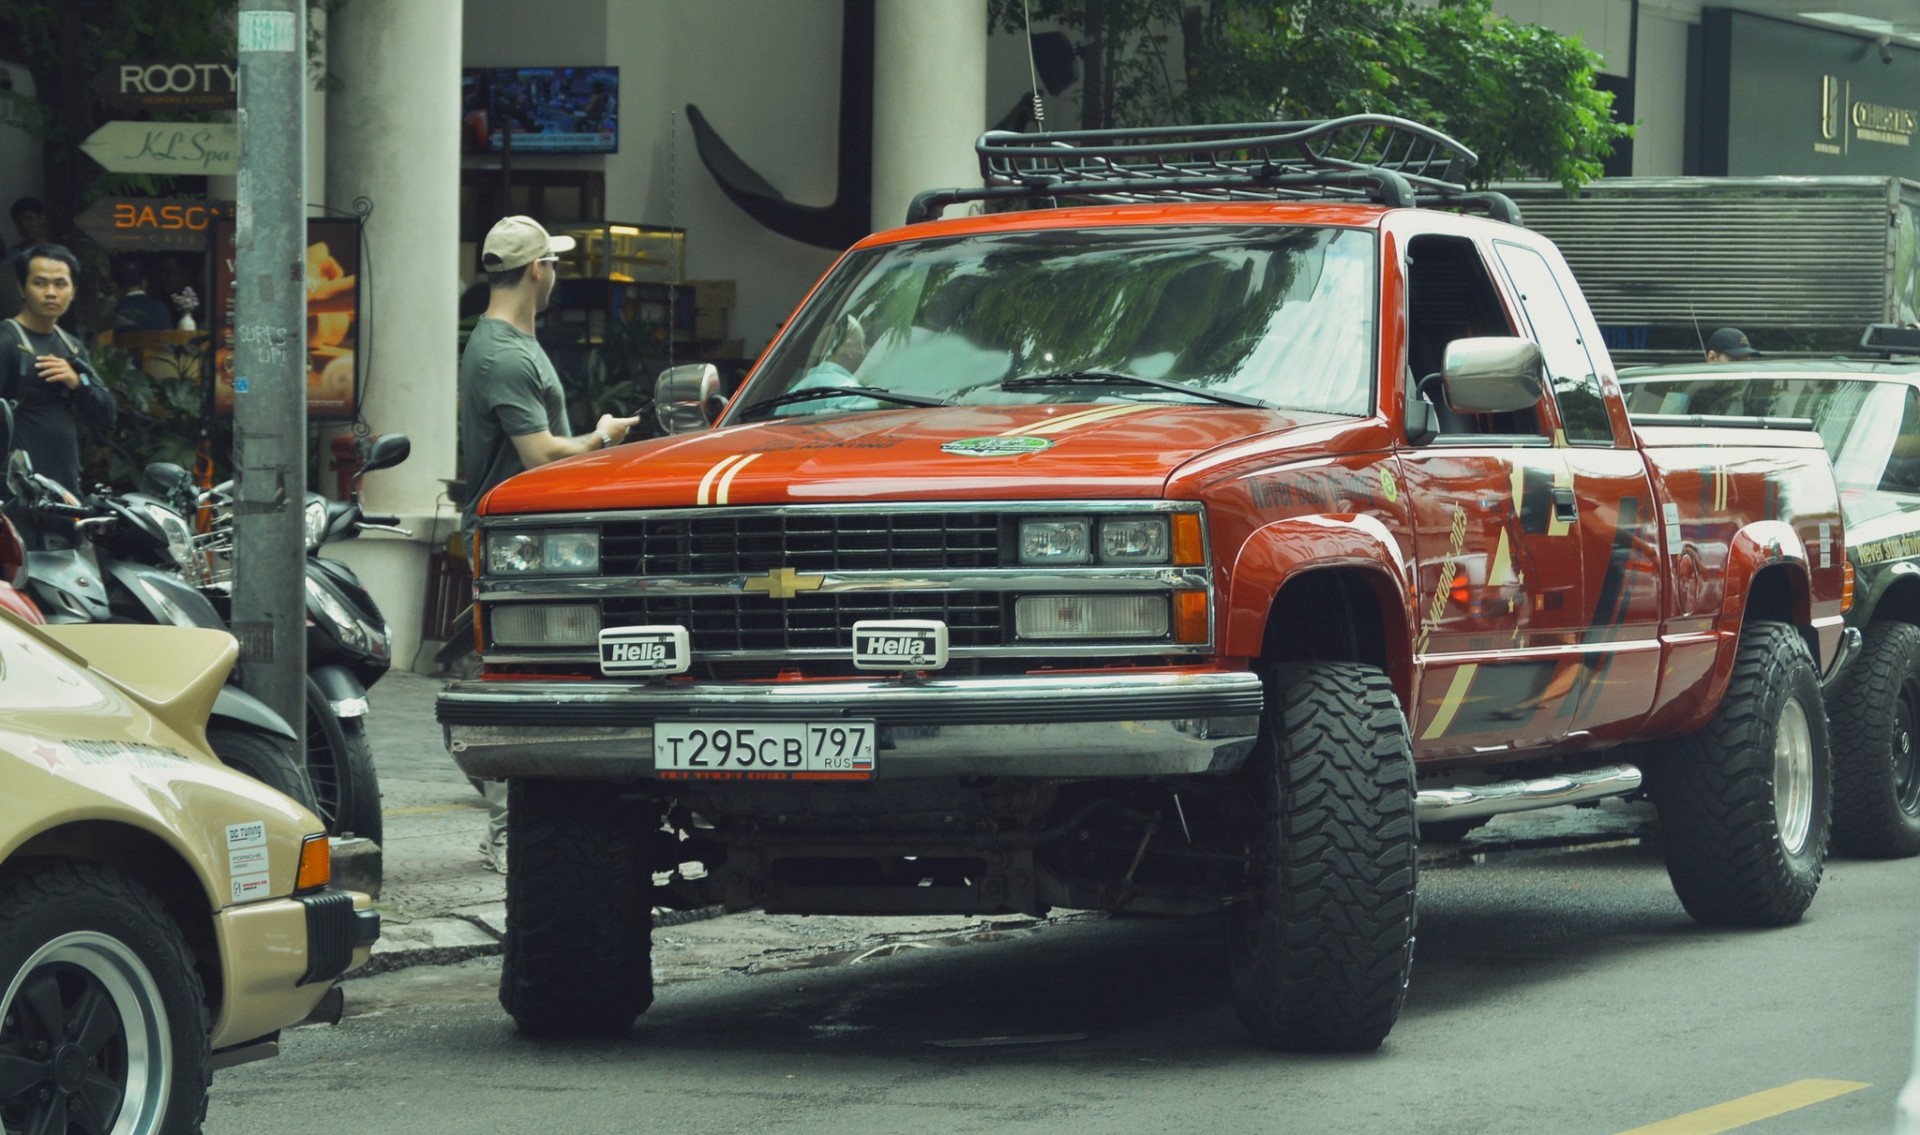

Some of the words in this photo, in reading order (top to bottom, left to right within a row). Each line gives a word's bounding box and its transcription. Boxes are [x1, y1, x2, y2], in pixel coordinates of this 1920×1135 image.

[181, 131, 230, 169] Spa
[1248, 476, 1292, 509] Never
[1856, 543, 1884, 565] Never
[612, 643, 666, 661] Hella
[866, 637, 925, 655] Hella
[811, 728, 866, 757] 797
[824, 757, 851, 769] RUS
